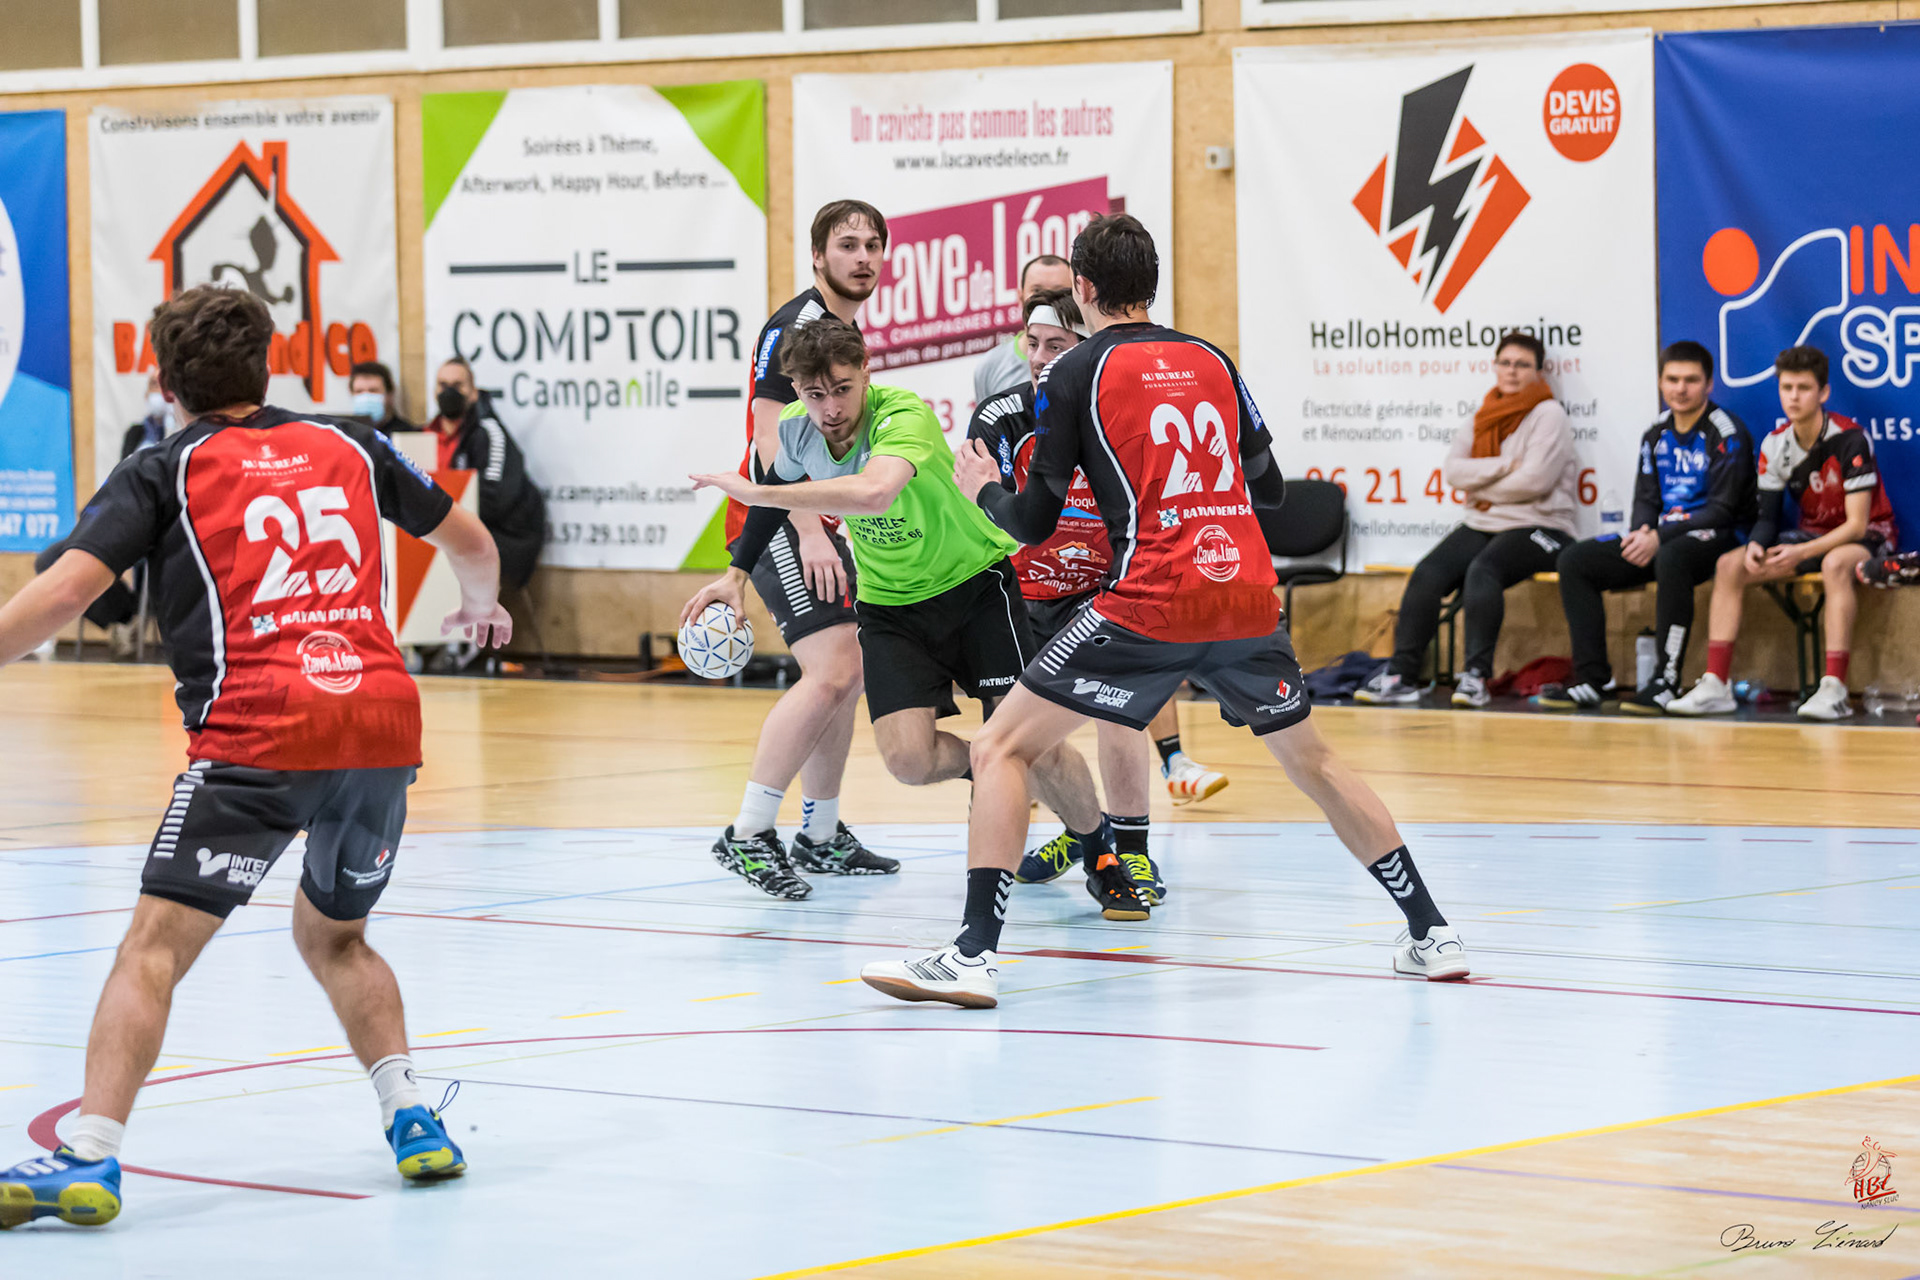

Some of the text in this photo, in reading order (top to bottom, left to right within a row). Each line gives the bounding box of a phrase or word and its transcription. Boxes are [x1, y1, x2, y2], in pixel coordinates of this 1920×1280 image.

[1549, 88, 1616, 116] DEVIS
[100, 107, 380, 134] Construisons ensemble votre avenir
[851, 99, 1113, 144] Un caviste pas comme les autres
[1549, 115, 1615, 135] GRATUIT
[523, 137, 583, 156] Soirées
[587, 137, 595, 155] à
[893, 148, 1071, 169] www.lacavedeleon.fr
[552, 173, 601, 193] Happy
[574, 250, 609, 284] LE
[969, 260, 994, 311] de
[452, 307, 742, 363] COMPTOIR
[890, 311, 992, 346] CHAMPAGNES
[1141, 370, 1195, 381] AU BUREAU
[1313, 359, 1331, 376] La
[1337, 358, 1413, 375] solution
[1419, 359, 1461, 378] pour
[511, 369, 680, 422] Campanile
[1377, 398, 1443, 421] générale
[1302, 427, 1318, 442] et
[1321, 424, 1403, 442] Rénovation
[1364, 467, 1407, 504] 21
[1577, 468, 1599, 505] 6
[1065, 495, 1096, 510] Hoqu
[1237, 503, 1252, 516] 54
[243, 485, 362, 605] 25
[1196, 545, 1217, 565] Cave
[1220, 543, 1241, 562] Léon
[1064, 562, 1079, 570] LE
[303, 653, 332, 674] Cave
[978, 675, 1016, 688] PATRICK
[1099, 682, 1134, 700] INTER
[1094, 694, 1129, 709] SPORT
[227, 868, 263, 887] SPOR
